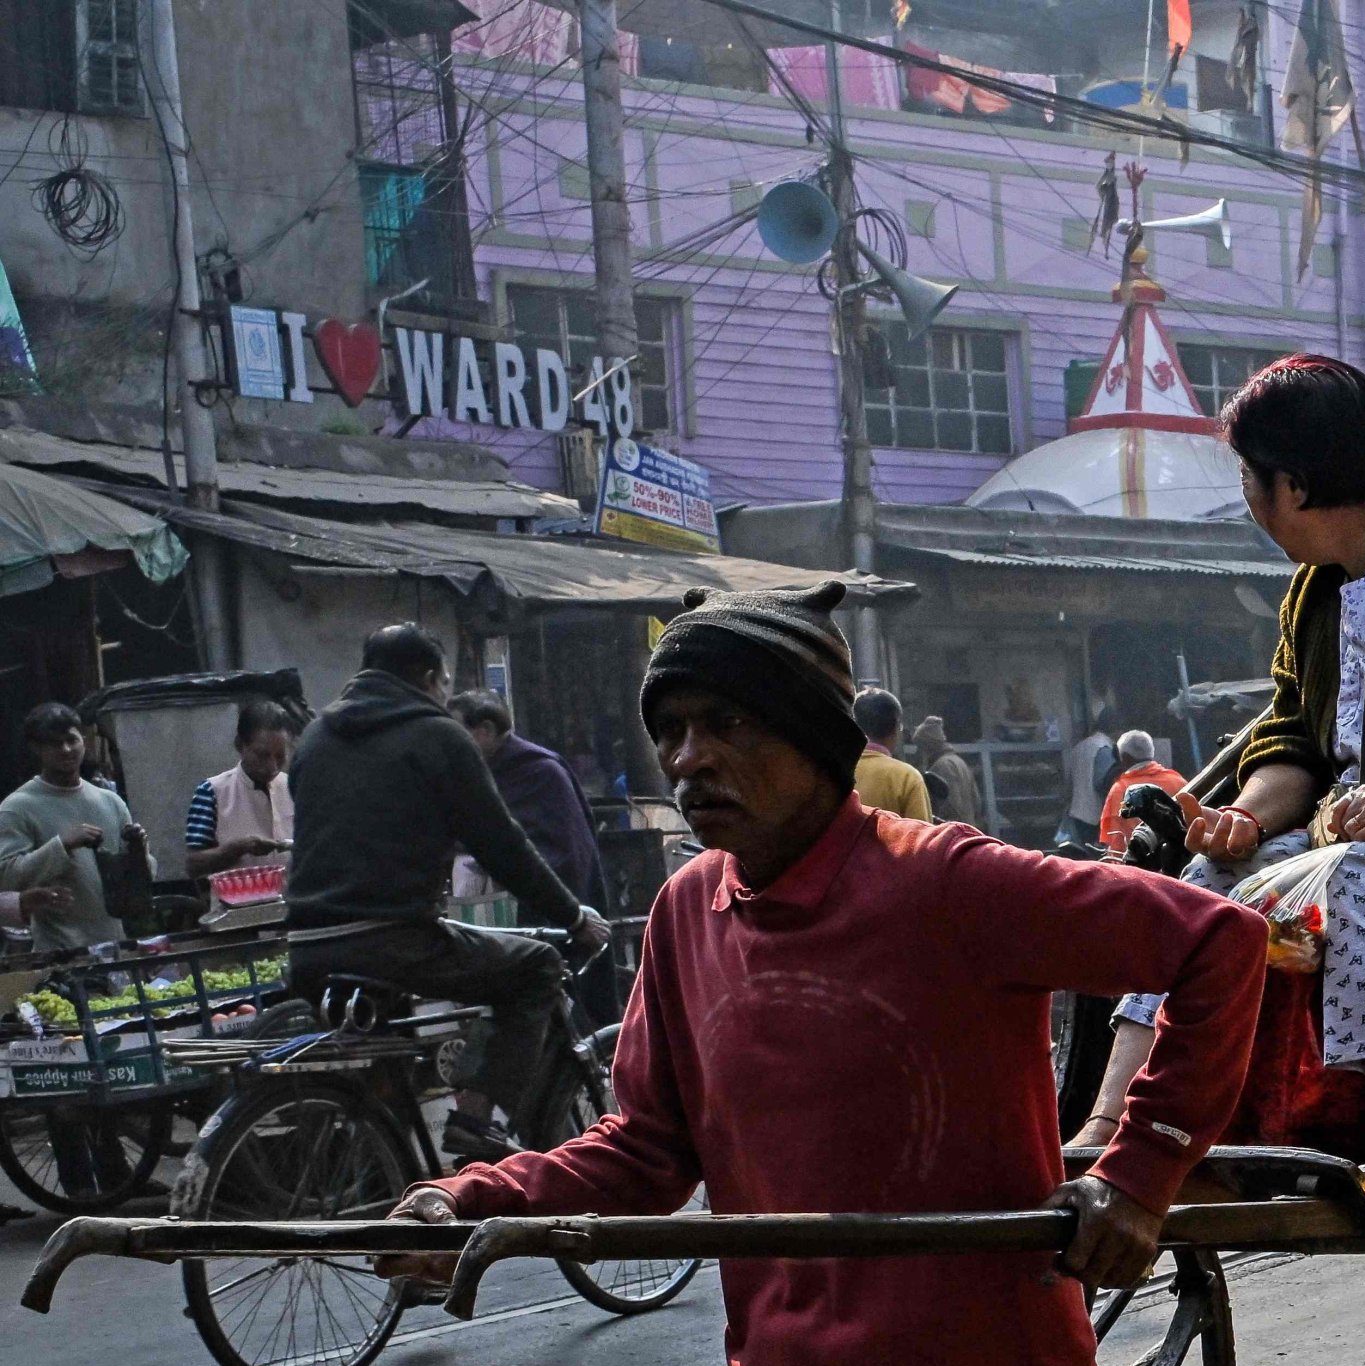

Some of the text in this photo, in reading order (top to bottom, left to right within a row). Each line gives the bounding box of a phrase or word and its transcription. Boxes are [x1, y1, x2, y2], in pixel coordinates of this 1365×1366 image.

[282, 312, 632, 438] I WARD 48
[631, 496, 681, 521] LOWER PRICE
[24, 1065, 137, 1087] Kasmir Apples
